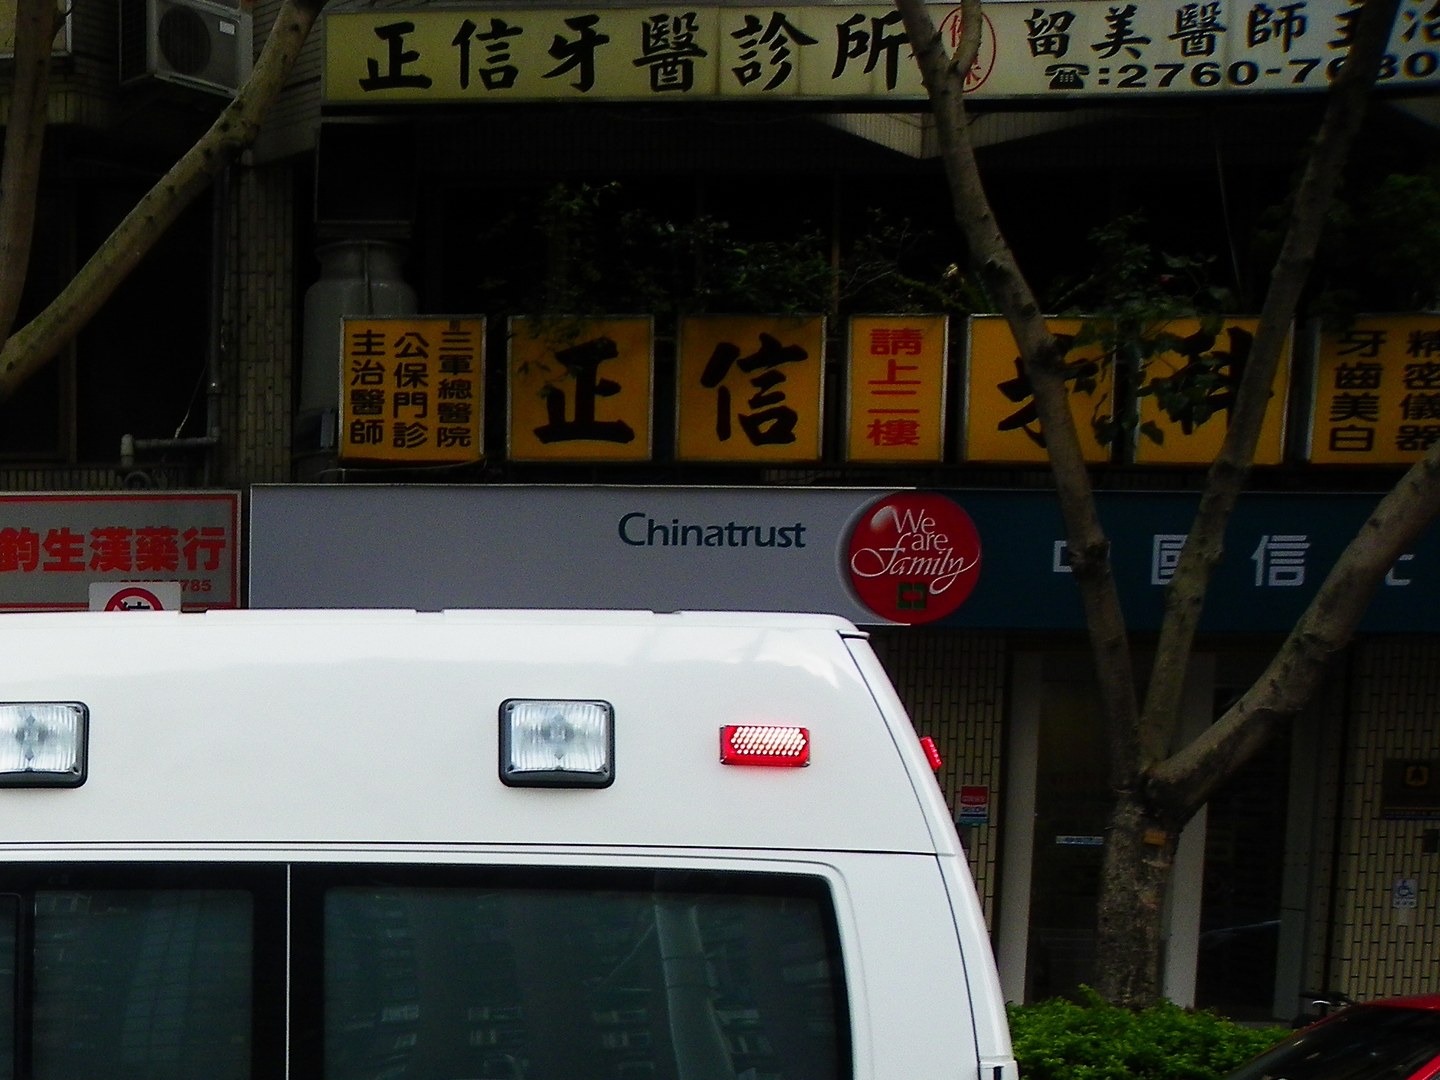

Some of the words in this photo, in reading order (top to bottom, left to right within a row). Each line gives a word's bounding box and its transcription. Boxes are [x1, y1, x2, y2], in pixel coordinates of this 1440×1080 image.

[360, 10, 914, 93] 正信牙醫診所
[350, 330, 386, 446] 主治醫師
[392, 331, 429, 449] 公保門診
[437, 330, 474, 448] 三軍總醫院
[866, 327, 924, 448] 請上二樓
[1328, 329, 1387, 452] 牙齒美白
[617, 511, 808, 551] Chinatrust
[851, 532, 981, 594] Family
[892, 505, 936, 533] We
[911, 532, 949, 551] are
